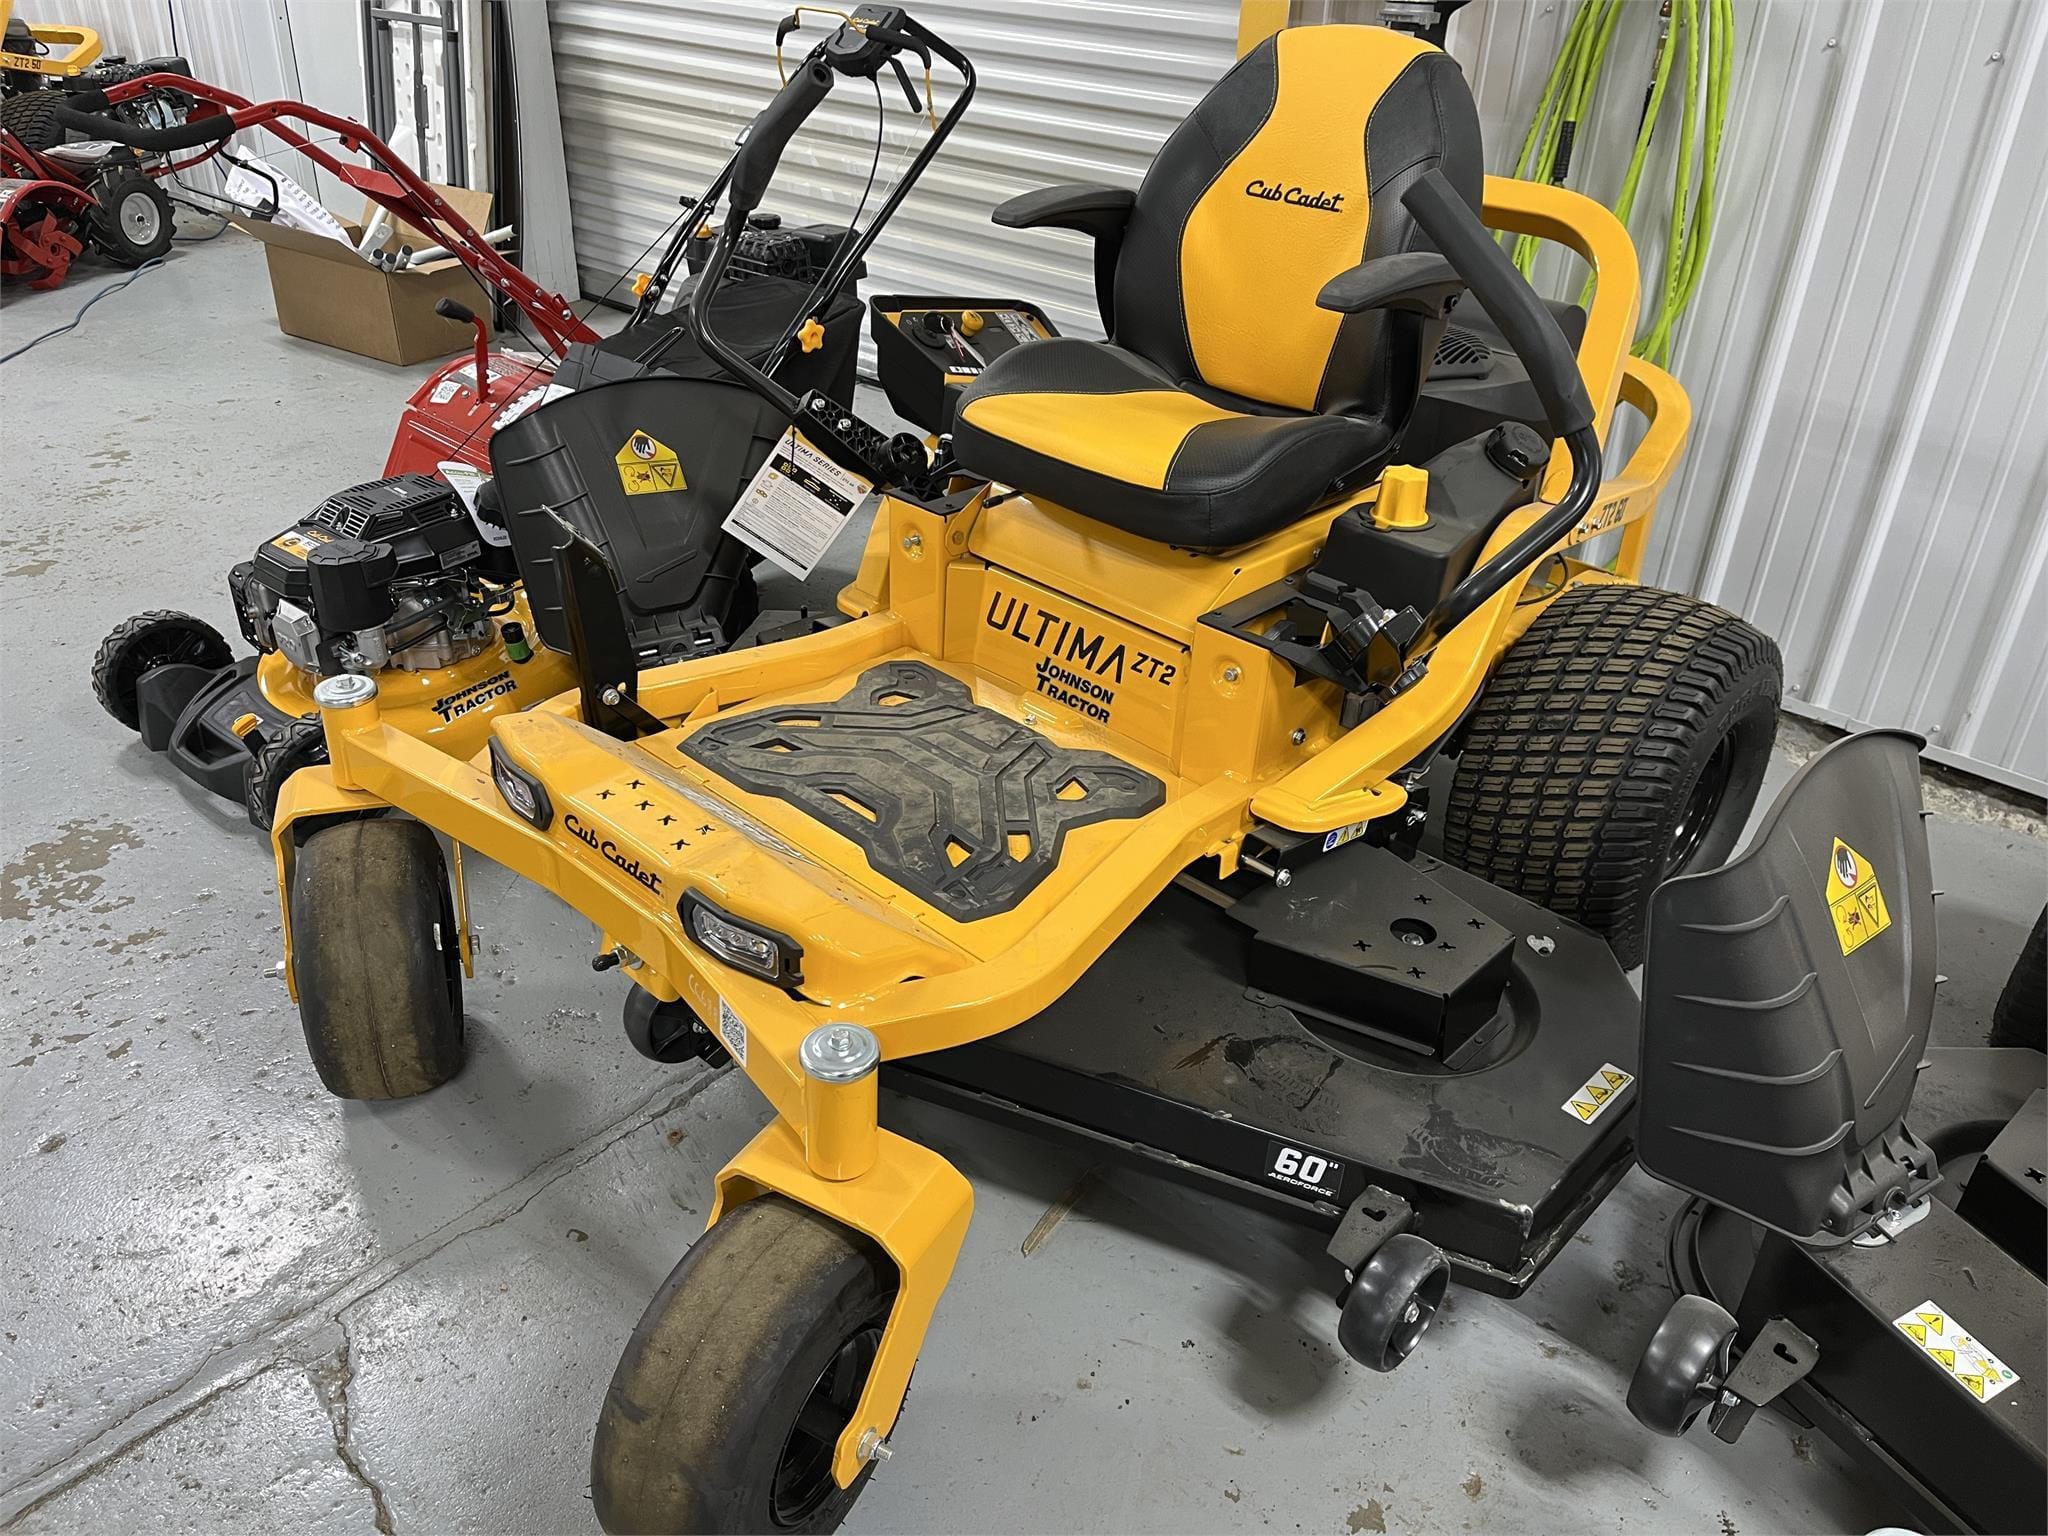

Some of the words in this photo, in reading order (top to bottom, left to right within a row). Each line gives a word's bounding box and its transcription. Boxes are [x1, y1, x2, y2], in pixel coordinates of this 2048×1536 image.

[14, 57, 30, 69] ZT2
[31, 59, 41, 70] 50
[1246, 180, 1282, 201] Cub
[1284, 187, 1344, 212] Cadet
[813, 456, 842, 477] SERIES
[986, 591, 1126, 684] ULTIMA
[1130, 652, 1176, 686] ZT2
[432, 671, 510, 712] JOHNSON
[438, 680, 518, 723] TRACTOR
[1036, 656, 1115, 705] JOHNSON
[1036, 673, 1111, 724] TRACTOR
[564, 814, 600, 849] Cub
[601, 841, 662, 896] Cadet
[1267, 1172, 1336, 1197] AEROFORCE
